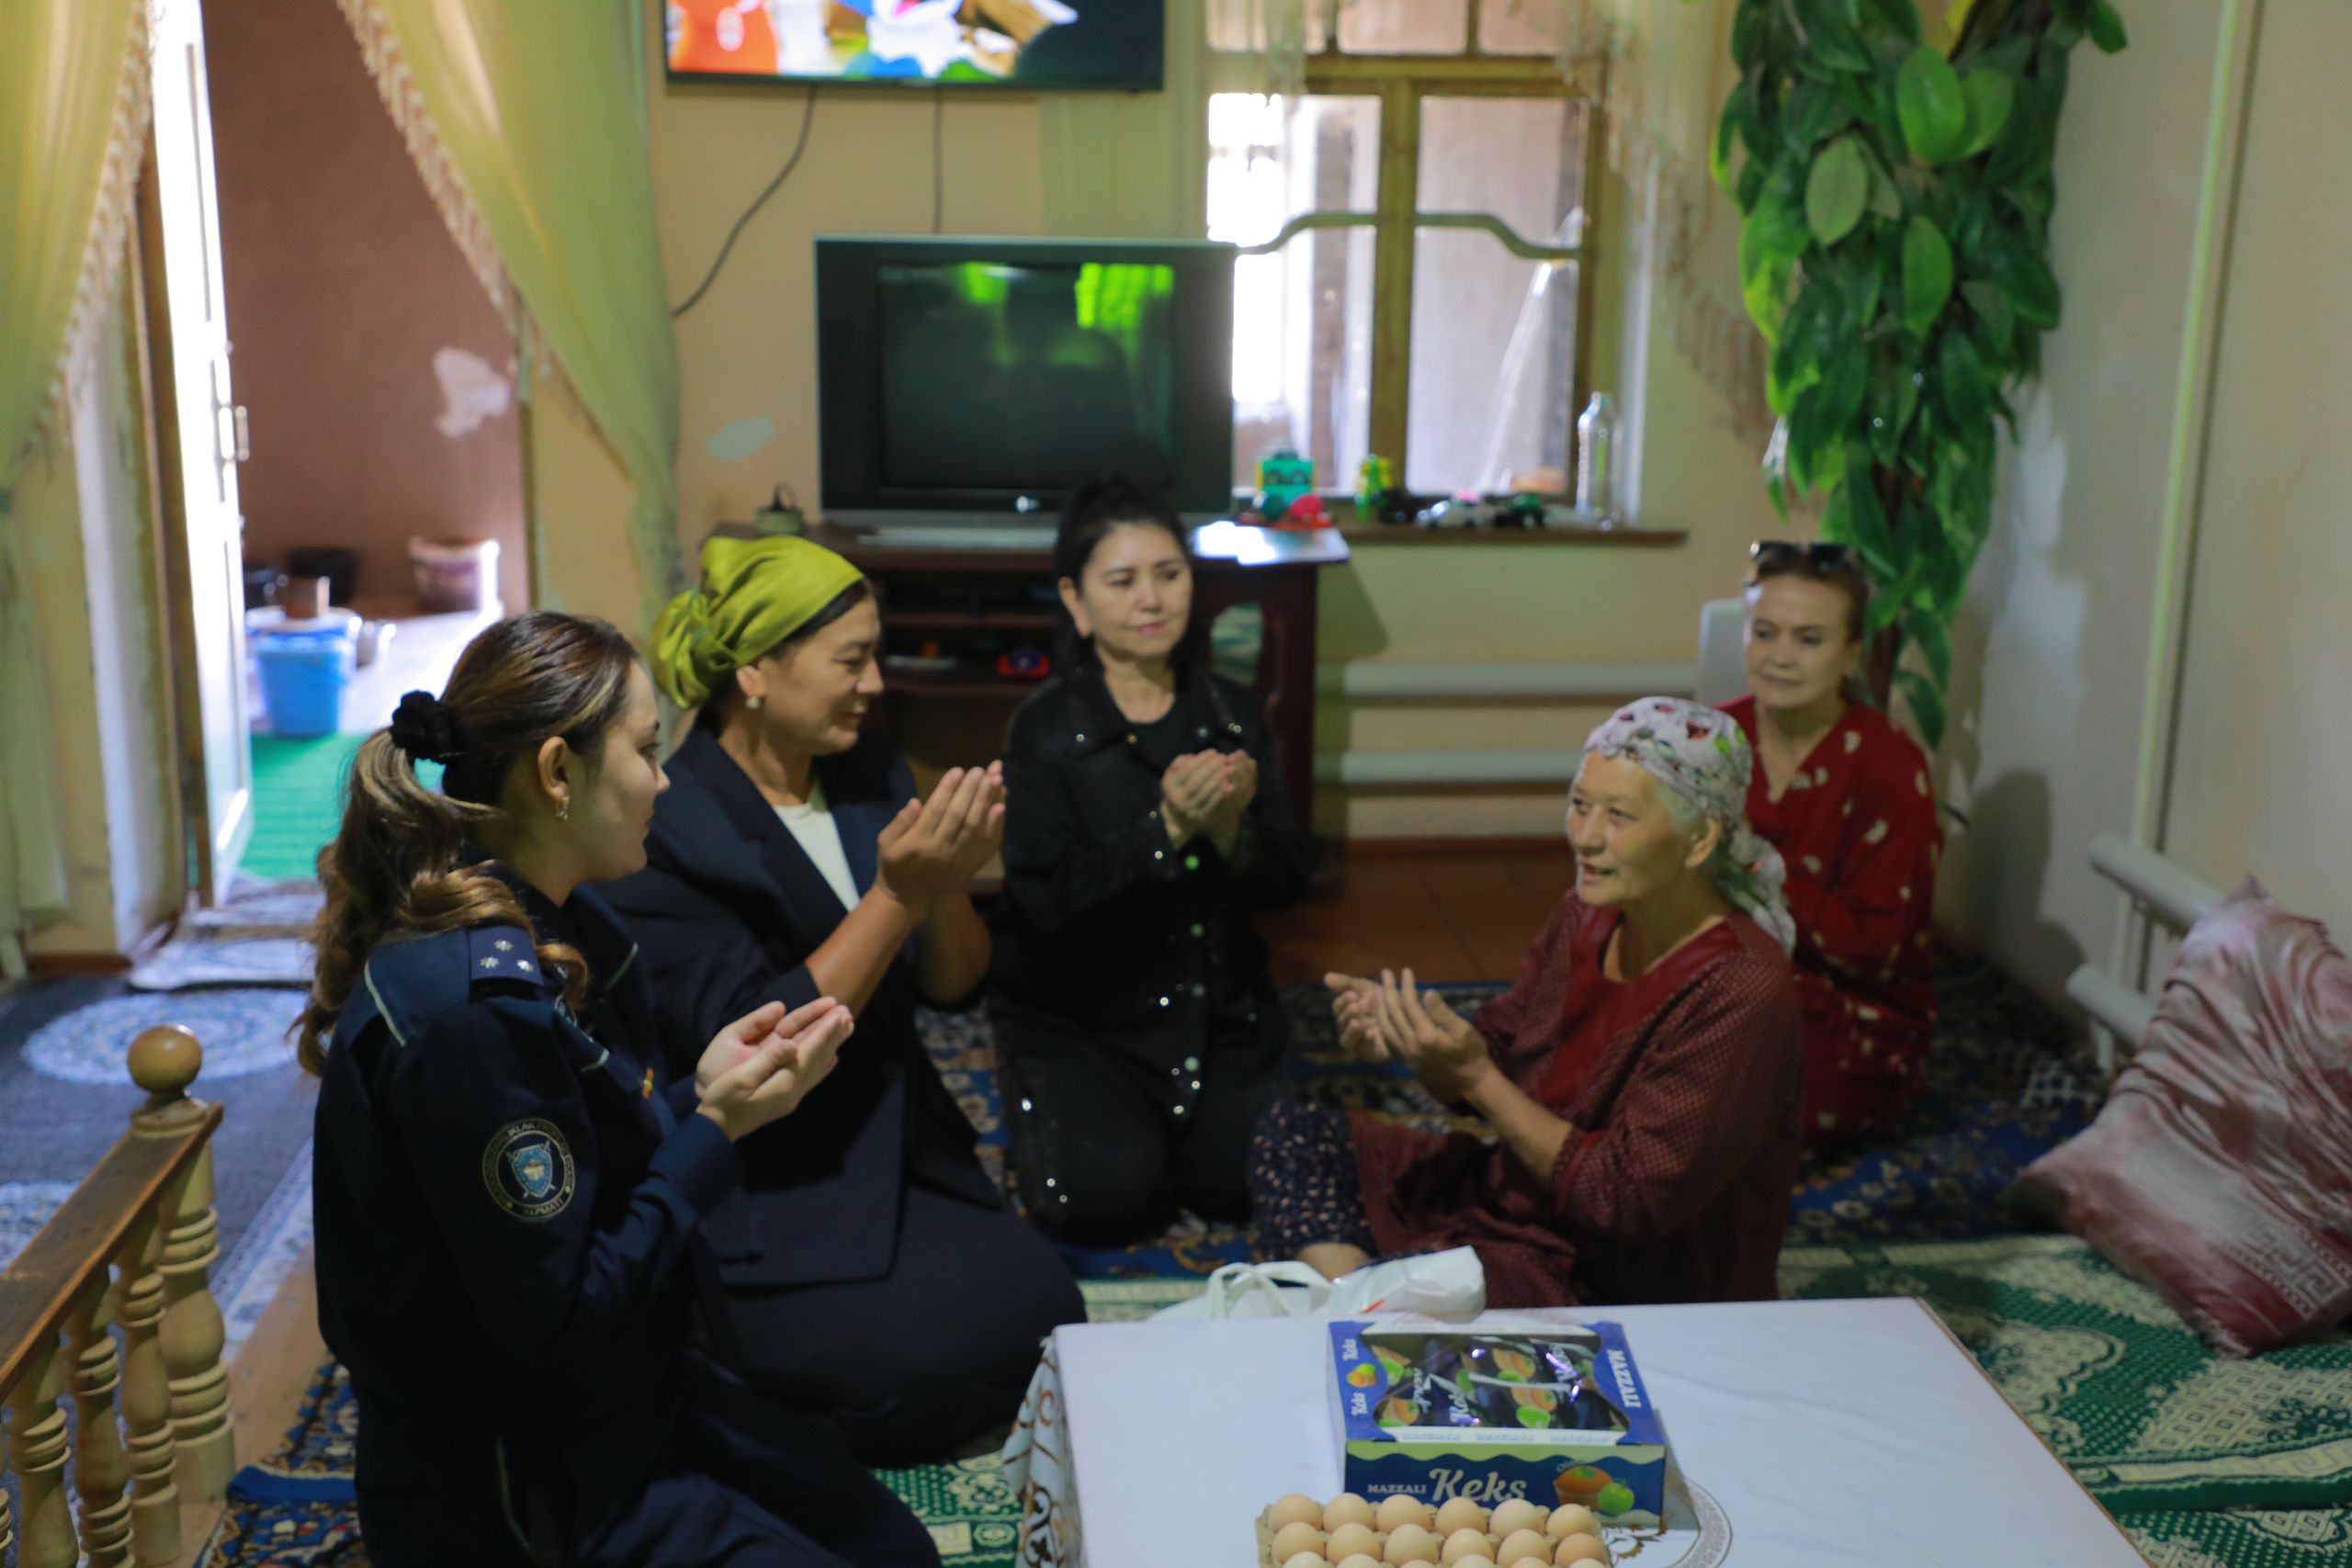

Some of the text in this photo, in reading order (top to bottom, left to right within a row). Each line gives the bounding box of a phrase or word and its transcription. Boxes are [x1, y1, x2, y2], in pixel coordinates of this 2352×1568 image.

[1607, 1348, 1642, 1408] MAZZALI
[1367, 1467, 1527, 1503] MAZZALI Keks
